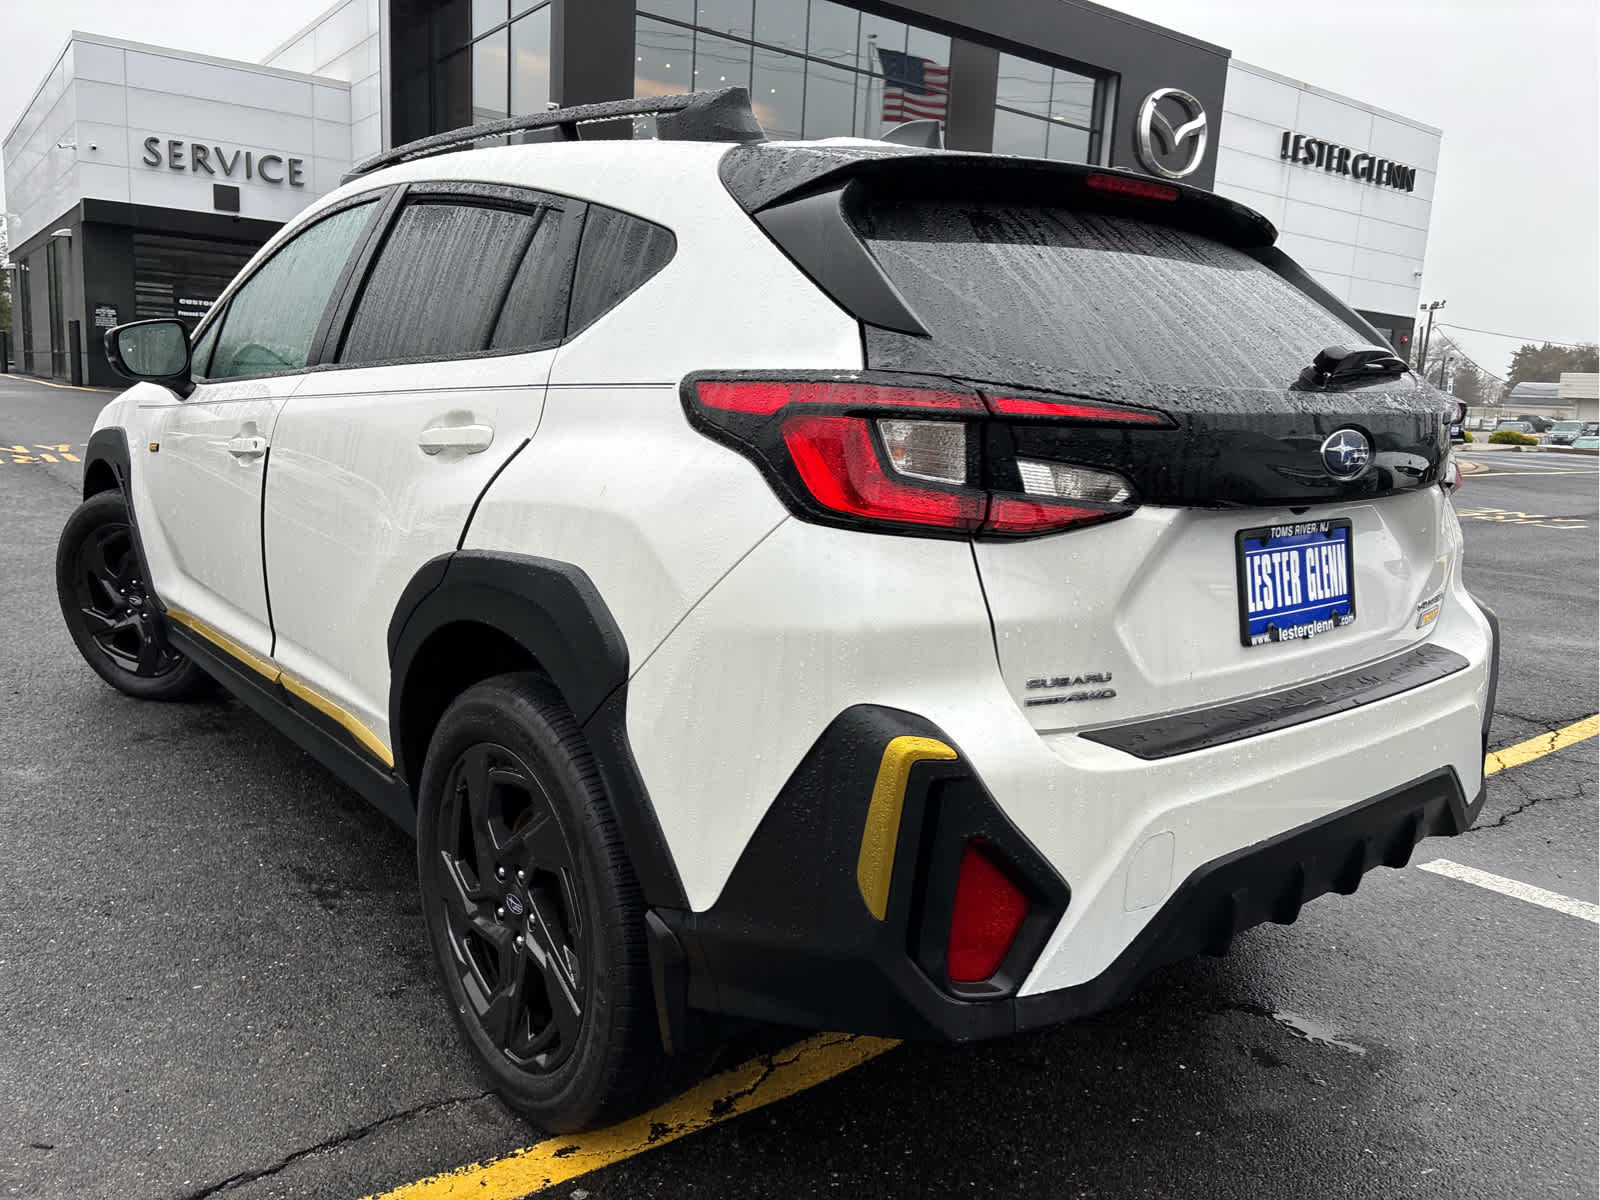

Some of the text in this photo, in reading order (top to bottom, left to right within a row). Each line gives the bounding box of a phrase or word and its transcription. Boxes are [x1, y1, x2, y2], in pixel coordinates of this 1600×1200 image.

[143, 136, 305, 187] SERVICE
[1280, 131, 1417, 192] LESTER GLENN
[1271, 525, 1293, 538] TOMS
[1319, 520, 1330, 532] NJ
[1246, 544, 1347, 613] LESTER GLENN
[1279, 620, 1334, 640] lesterglenn
[1026, 672, 1112, 688] SUBARU
